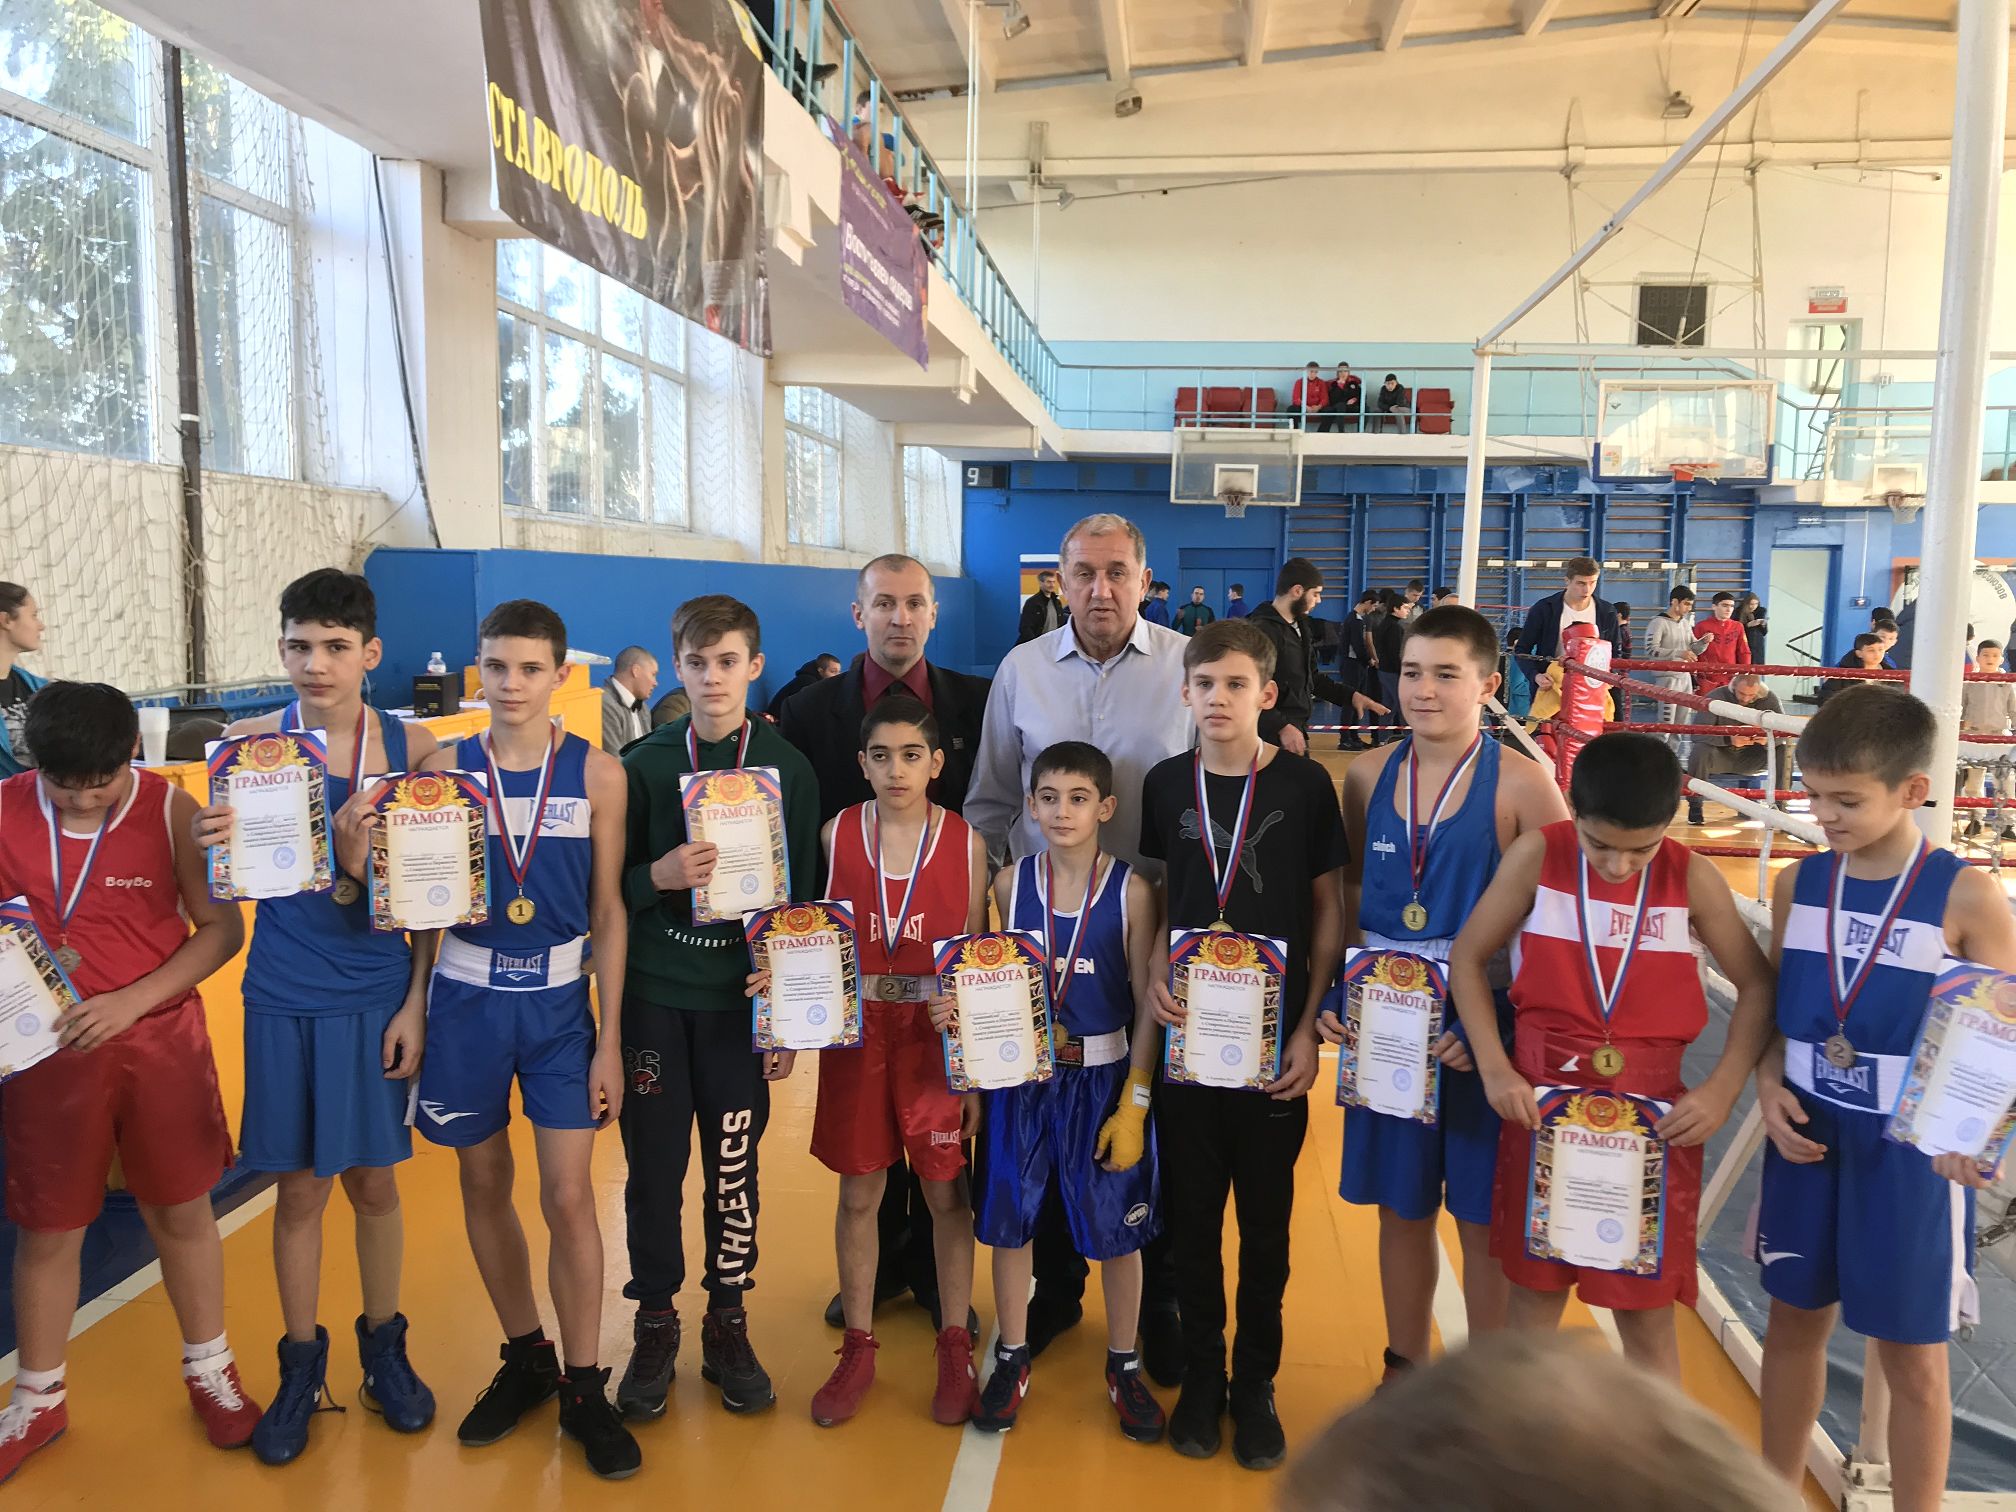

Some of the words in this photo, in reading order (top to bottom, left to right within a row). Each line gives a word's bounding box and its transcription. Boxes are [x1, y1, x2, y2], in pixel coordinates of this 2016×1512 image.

[489, 81, 648, 240] СТАВРОПОЛЬ
[967, 467, 980, 486] 9
[235, 771, 303, 789] ГРАМОТА
[393, 811, 463, 826] ГРАМОТА
[706, 805, 763, 820] ГРАМОТА
[339, 884, 351, 897] 2
[515, 903, 526, 917] 1
[1410, 910, 1418, 923] 1
[772, 935, 835, 950] ГРАМОТА
[495, 953, 544, 976] EVERLAST
[960, 969, 1024, 986] ГРАМОТА
[1194, 968, 1261, 986] ГРАМОТА
[885, 982, 896, 995] 2
[1368, 988, 1428, 1011] ГРАМОТА
[1957, 1012, 2016, 1043] ГРАМО
[1832, 1043, 1845, 1060] 2
[1603, 1054, 1613, 1068] 1
[1560, 1130, 1639, 1152] ГРАМОТА
[717, 1109, 752, 1286] ATHLETICS
